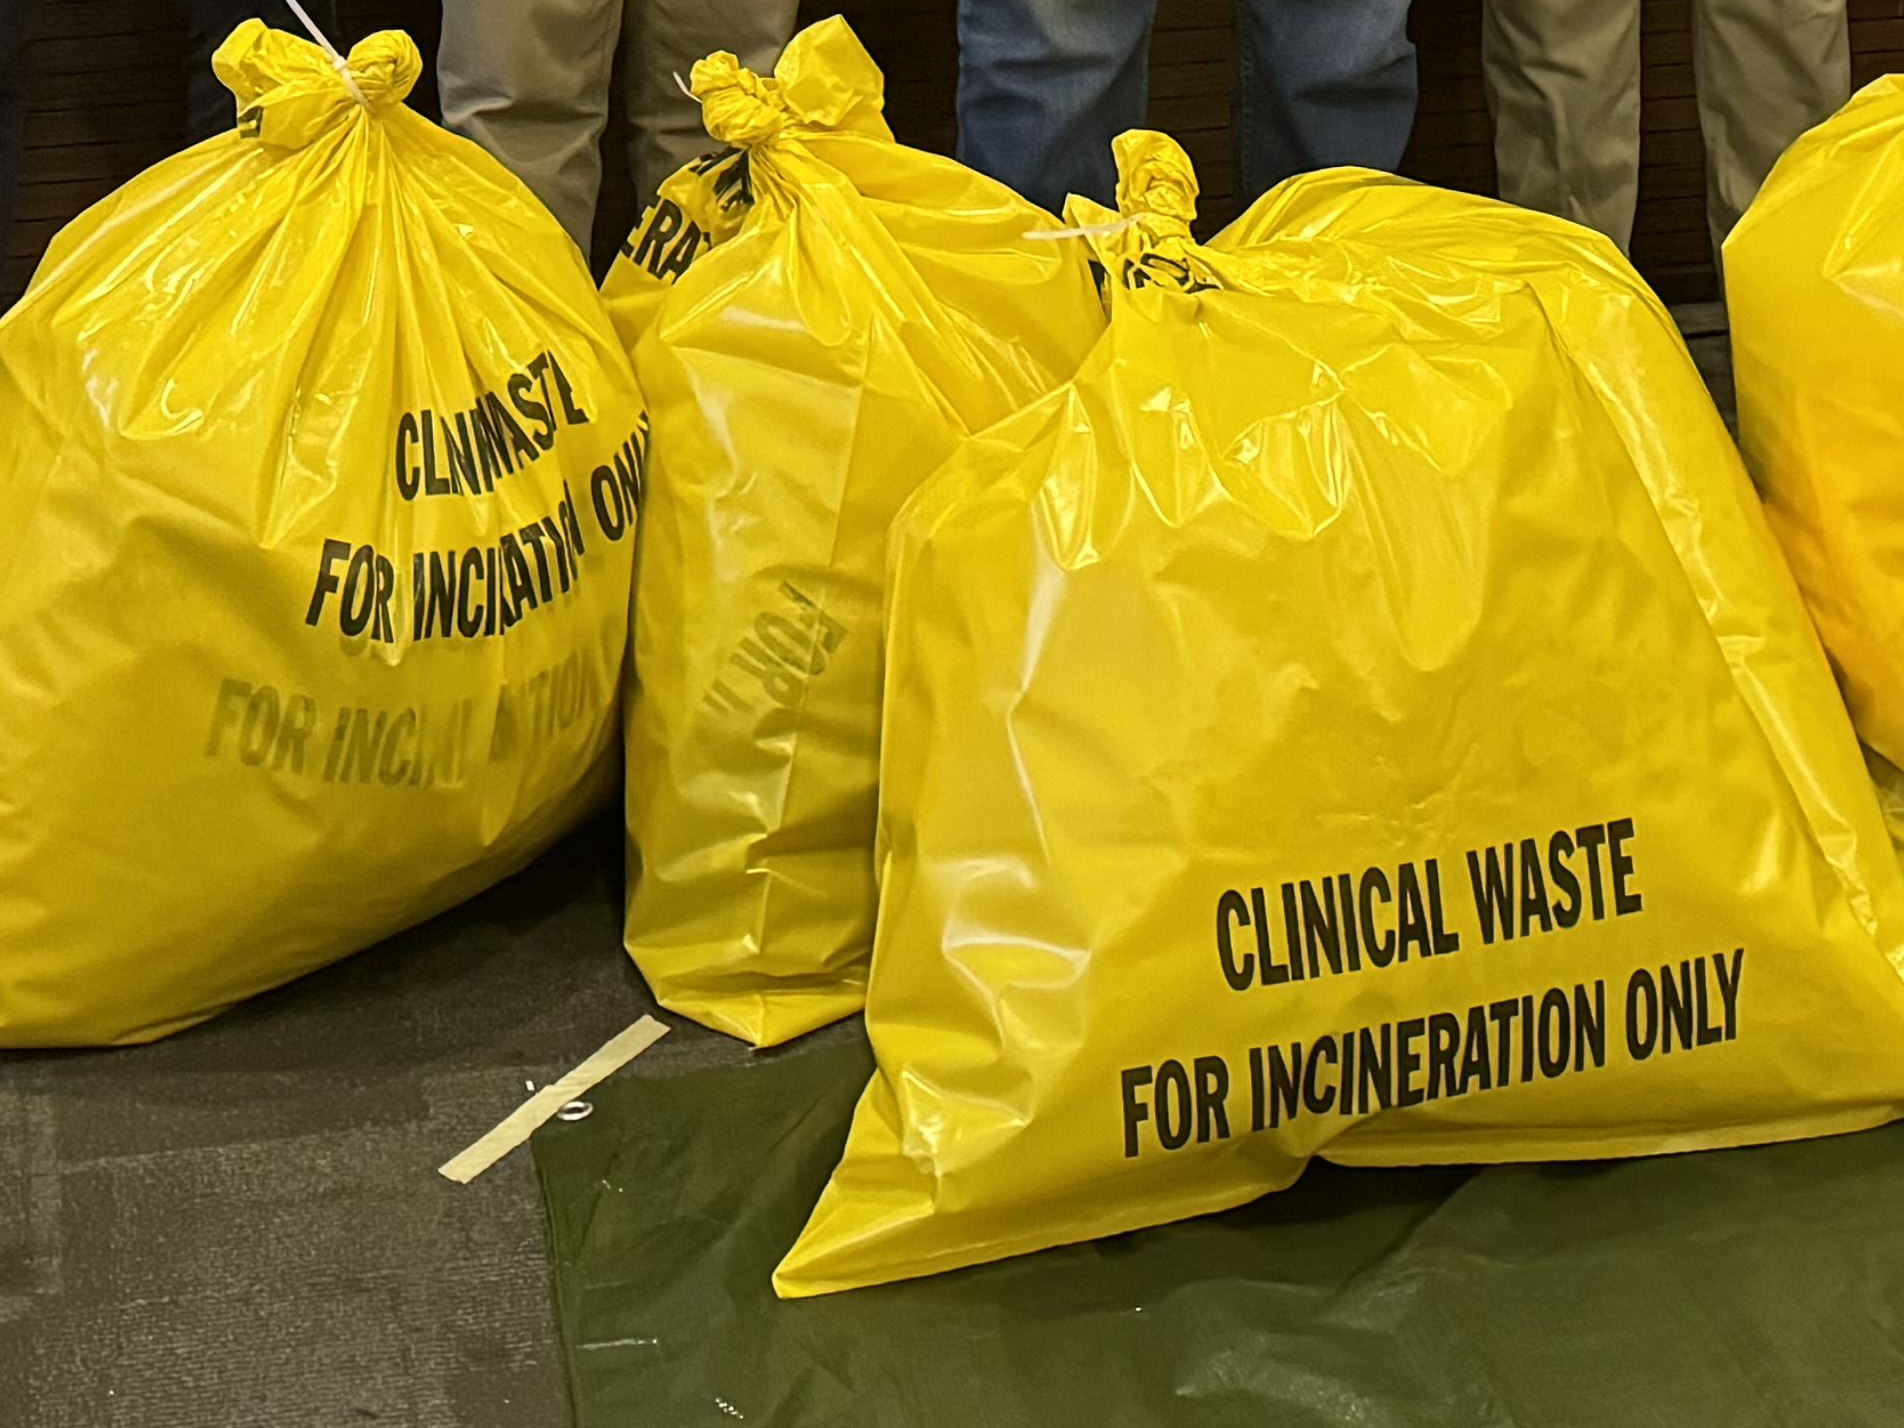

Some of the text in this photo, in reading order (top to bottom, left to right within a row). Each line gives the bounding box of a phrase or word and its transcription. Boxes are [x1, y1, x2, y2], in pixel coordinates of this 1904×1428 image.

[305, 538, 395, 644] FOR
[1215, 817, 1643, 993] CLINICAL WASTE
[1120, 948, 1746, 1158] FOR INCINERATION ONLY
